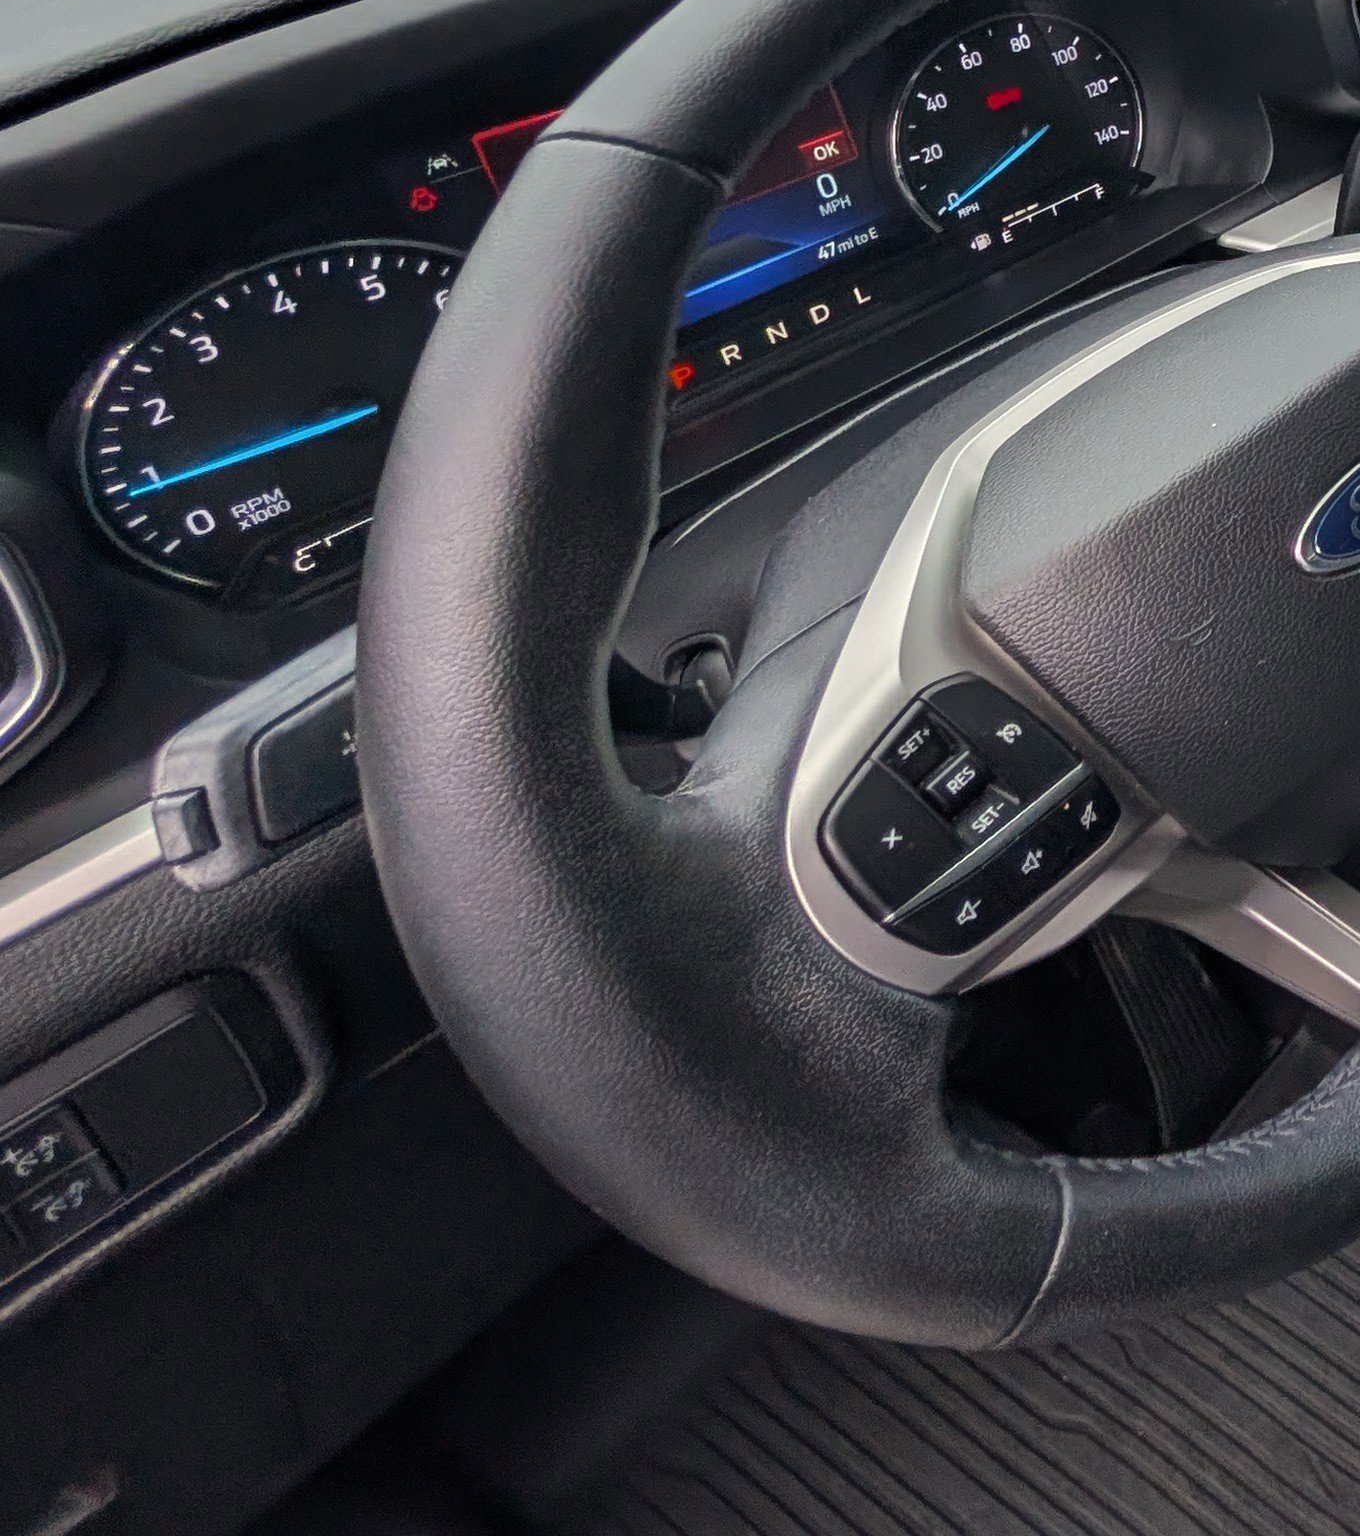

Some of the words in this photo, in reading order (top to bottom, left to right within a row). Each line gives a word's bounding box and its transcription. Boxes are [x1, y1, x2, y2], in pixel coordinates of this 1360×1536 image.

[1009, 33, 1032, 53] 80
[1051, 45, 1078, 67] 100
[960, 50, 983, 71] 60
[1084, 78, 1109, 99] 120
[925, 93, 948, 112] 40
[1093, 124, 1119, 146] 140
[812, 139, 840, 162] OK
[920, 143, 944, 164] 20
[815, 172, 839, 199] 0
[1094, 186, 1105, 200] F
[818, 194, 853, 217] MPH
[957, 201, 980, 219] MPH
[817, 240, 838, 261] 47
[837, 235, 855, 254] mi
[854, 231, 869, 248] to
[867, 226, 880, 241] E
[1001, 229, 1014, 244] E
[360, 274, 386, 302] 5
[272, 289, 298, 315] 4
[189, 335, 219, 363] 3
[669, 362, 695, 391] P
[720, 343, 743, 366] R
[765, 321, 790, 345] N
[808, 303, 831, 326] D
[852, 286, 872, 305] L
[142, 397, 175, 426] 2
[229, 486, 286, 520] RPM
[237, 498, 293, 531] x1000
[185, 508, 216, 536] 0
[897, 726, 931, 761] SET+
[945, 765, 976, 796] RES
[970, 801, 1005, 834] SET-
